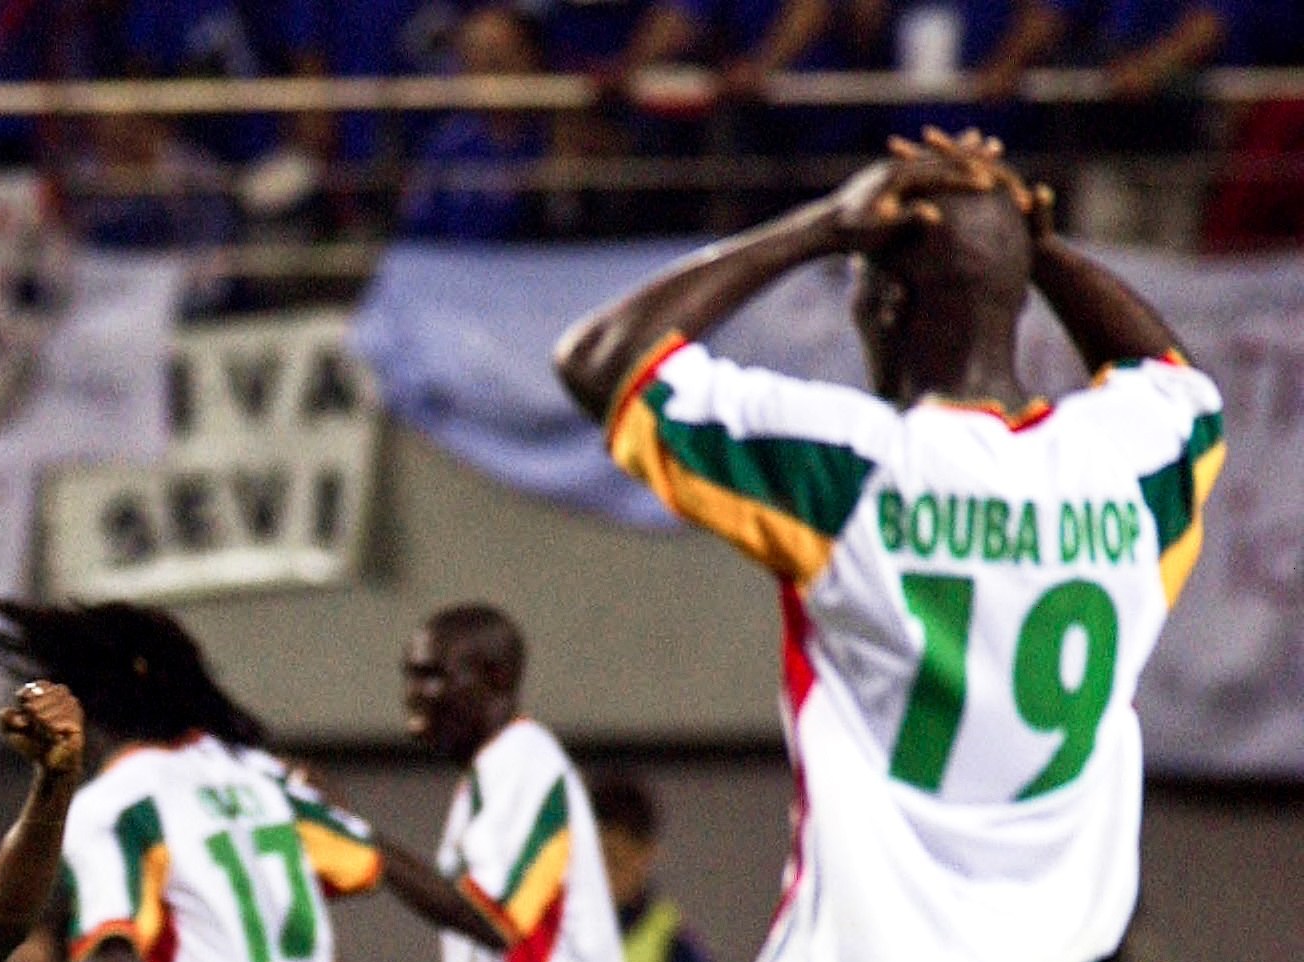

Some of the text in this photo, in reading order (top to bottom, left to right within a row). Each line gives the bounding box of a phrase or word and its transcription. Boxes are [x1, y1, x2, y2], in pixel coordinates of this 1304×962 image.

[166, 340, 360, 440] IVA
[877, 488, 1140, 566] BOUBA DIOP
[889, 571, 1120, 804] 19
